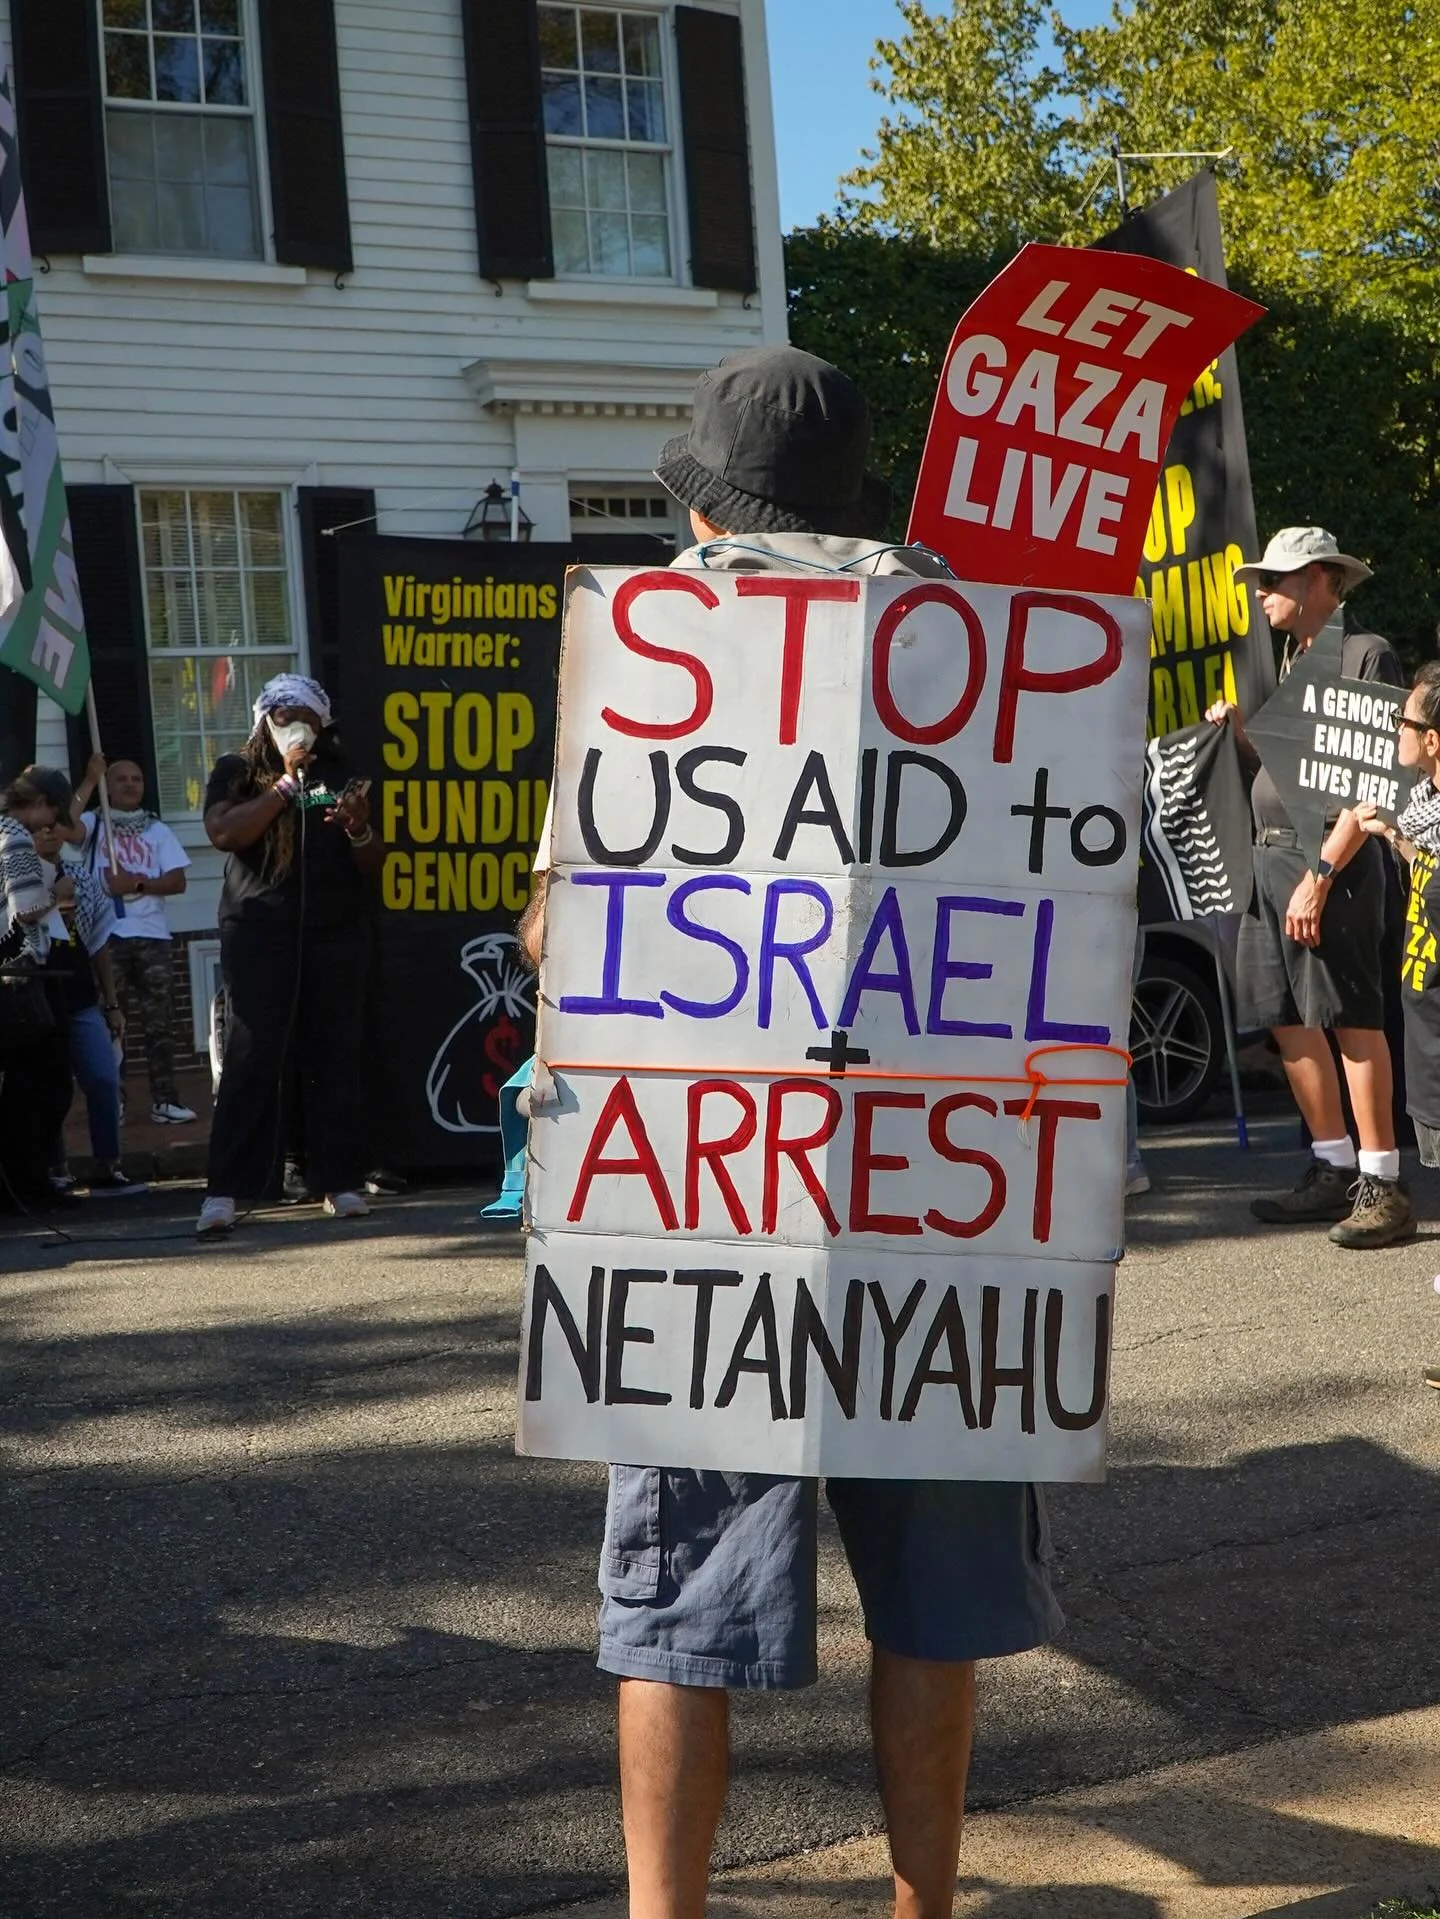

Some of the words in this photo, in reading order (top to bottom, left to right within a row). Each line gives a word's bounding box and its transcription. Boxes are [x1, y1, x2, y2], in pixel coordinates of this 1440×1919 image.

[1016, 280, 1194, 359] LET
[946, 334, 1167, 463] GAZA
[943, 436, 1130, 556] LIVE
[382, 625, 520, 668] Warner:
[383, 576, 557, 624] Virginians
[1134, 544, 1249, 659] MING
[601, 571, 1122, 763] STOP
[1302, 684, 1317, 713] A
[382, 692, 535, 772] STOP
[1314, 723, 1395, 771] ENABLER
[1011, 767, 1127, 874] to
[1298, 758, 1353, 797] LIVES
[1356, 771, 1399, 811] HERE
[559, 873, 1111, 1044] ISRAEL
[1407, 925, 1437, 963] ZA
[567, 1075, 1102, 1243] ARREST
[526, 1264, 1109, 1433] NETANYAHU
